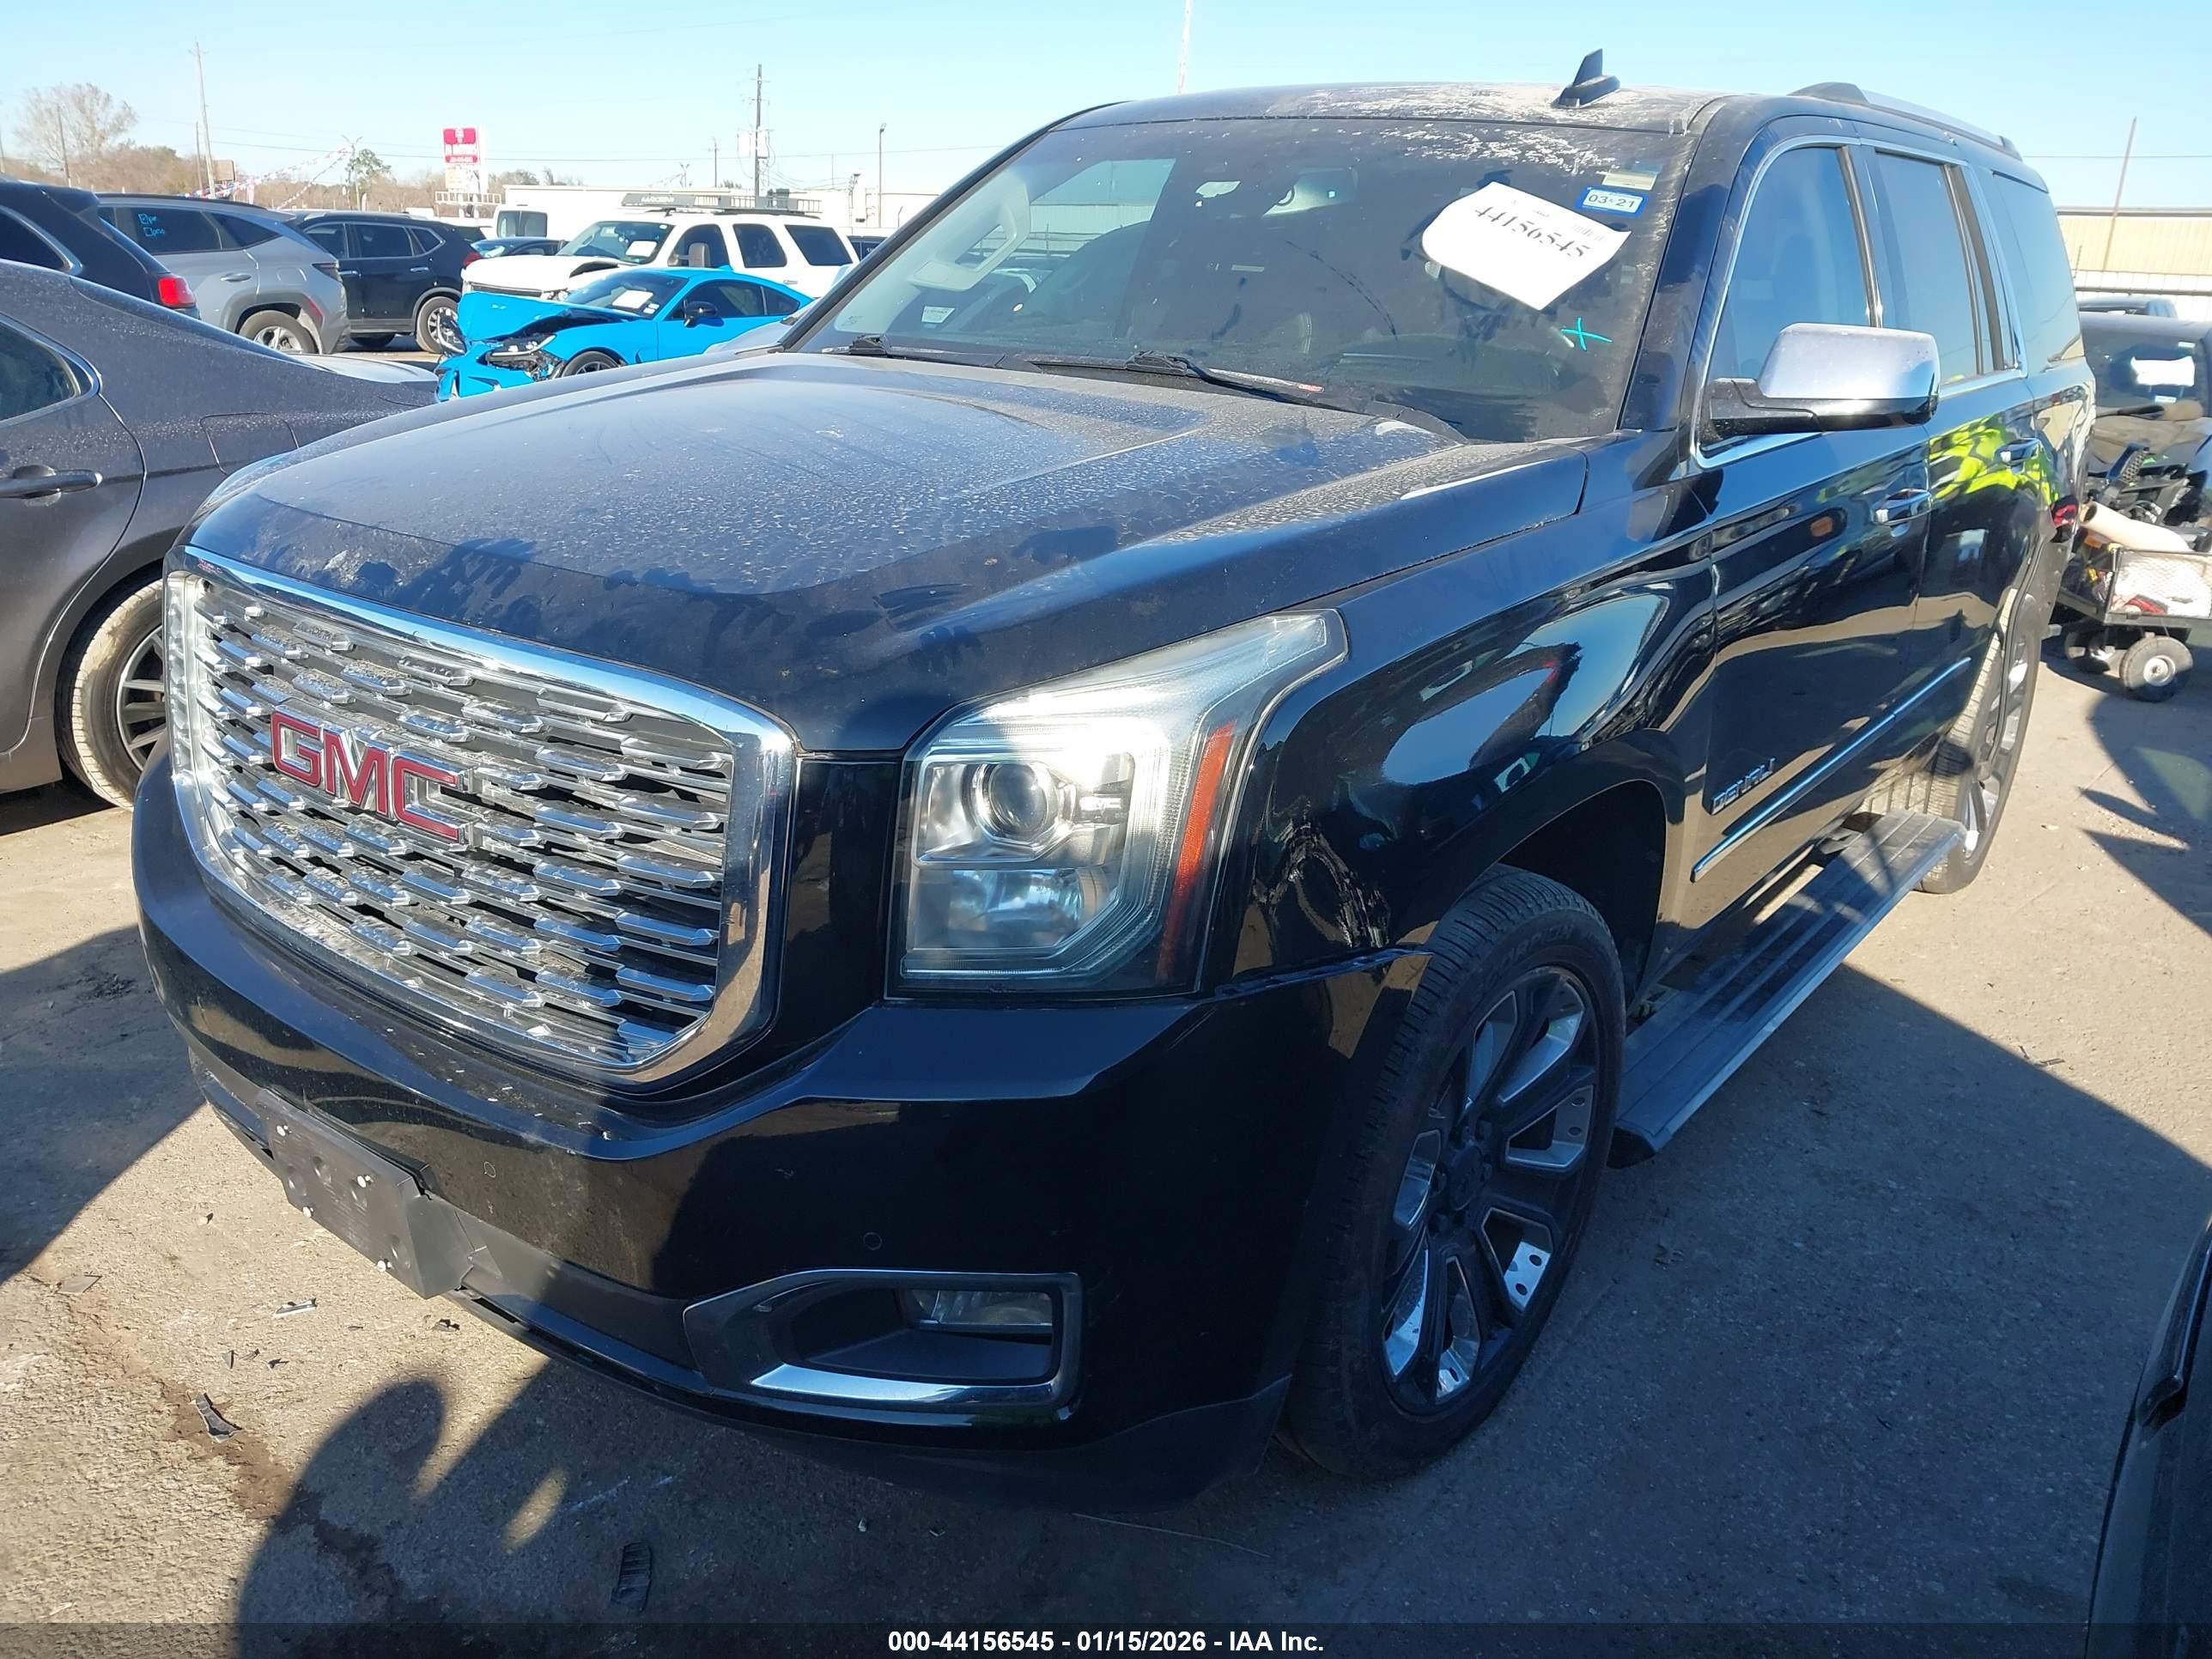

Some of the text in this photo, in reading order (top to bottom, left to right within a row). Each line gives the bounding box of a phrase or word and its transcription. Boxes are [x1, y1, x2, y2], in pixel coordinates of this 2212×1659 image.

[1588, 194, 1635, 209] 03 21
[1473, 204, 1592, 258] 44156545
[270, 708, 464, 844] GMC
[1712, 757, 1777, 815] DENALI
